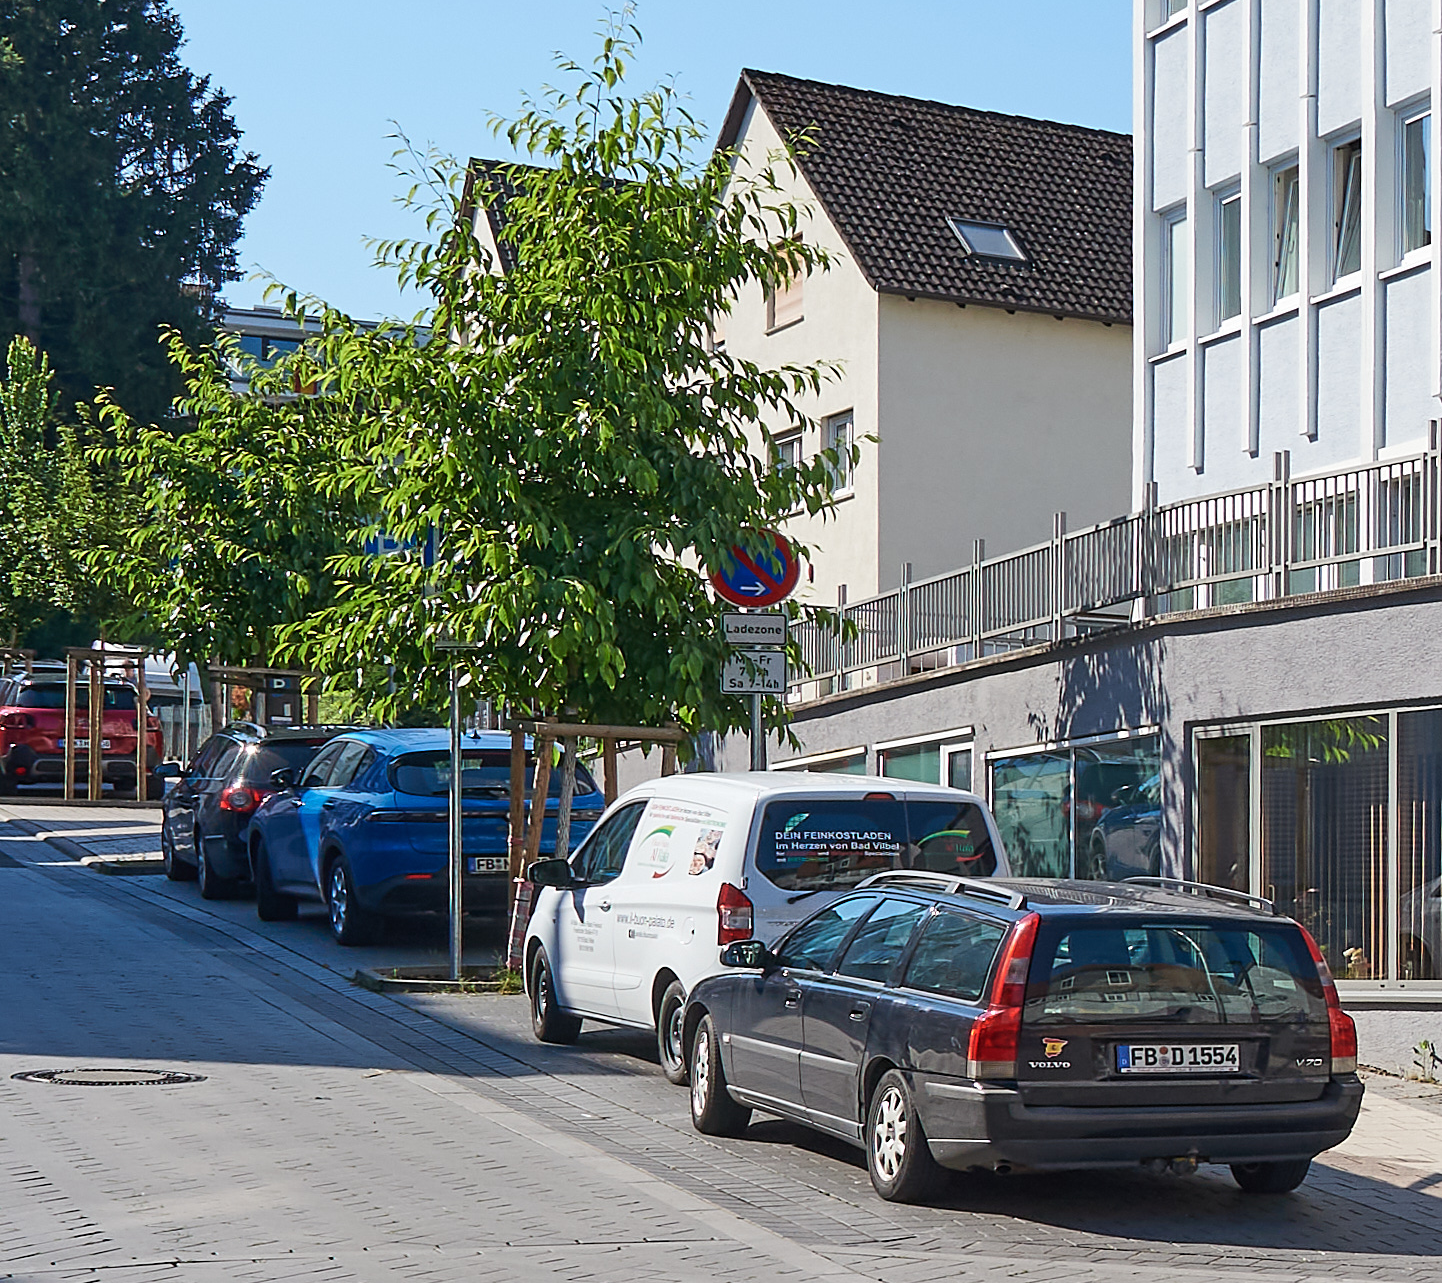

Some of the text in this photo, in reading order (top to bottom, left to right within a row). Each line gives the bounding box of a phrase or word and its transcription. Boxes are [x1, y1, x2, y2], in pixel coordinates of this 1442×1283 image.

[726, 624, 782, 635] Ladezone
[736, 655, 772, 665] M-Fr
[729, 678, 779, 689] Sa 7-14h
[775, 831, 892, 840] DEIN FEINKOSTLADEN
[791, 842, 827, 850] Herzen
[851, 842, 870, 850] Bad
[1131, 1046, 1238, 1066] FB D 1554
[1028, 1061, 1071, 1069] VOLVO
